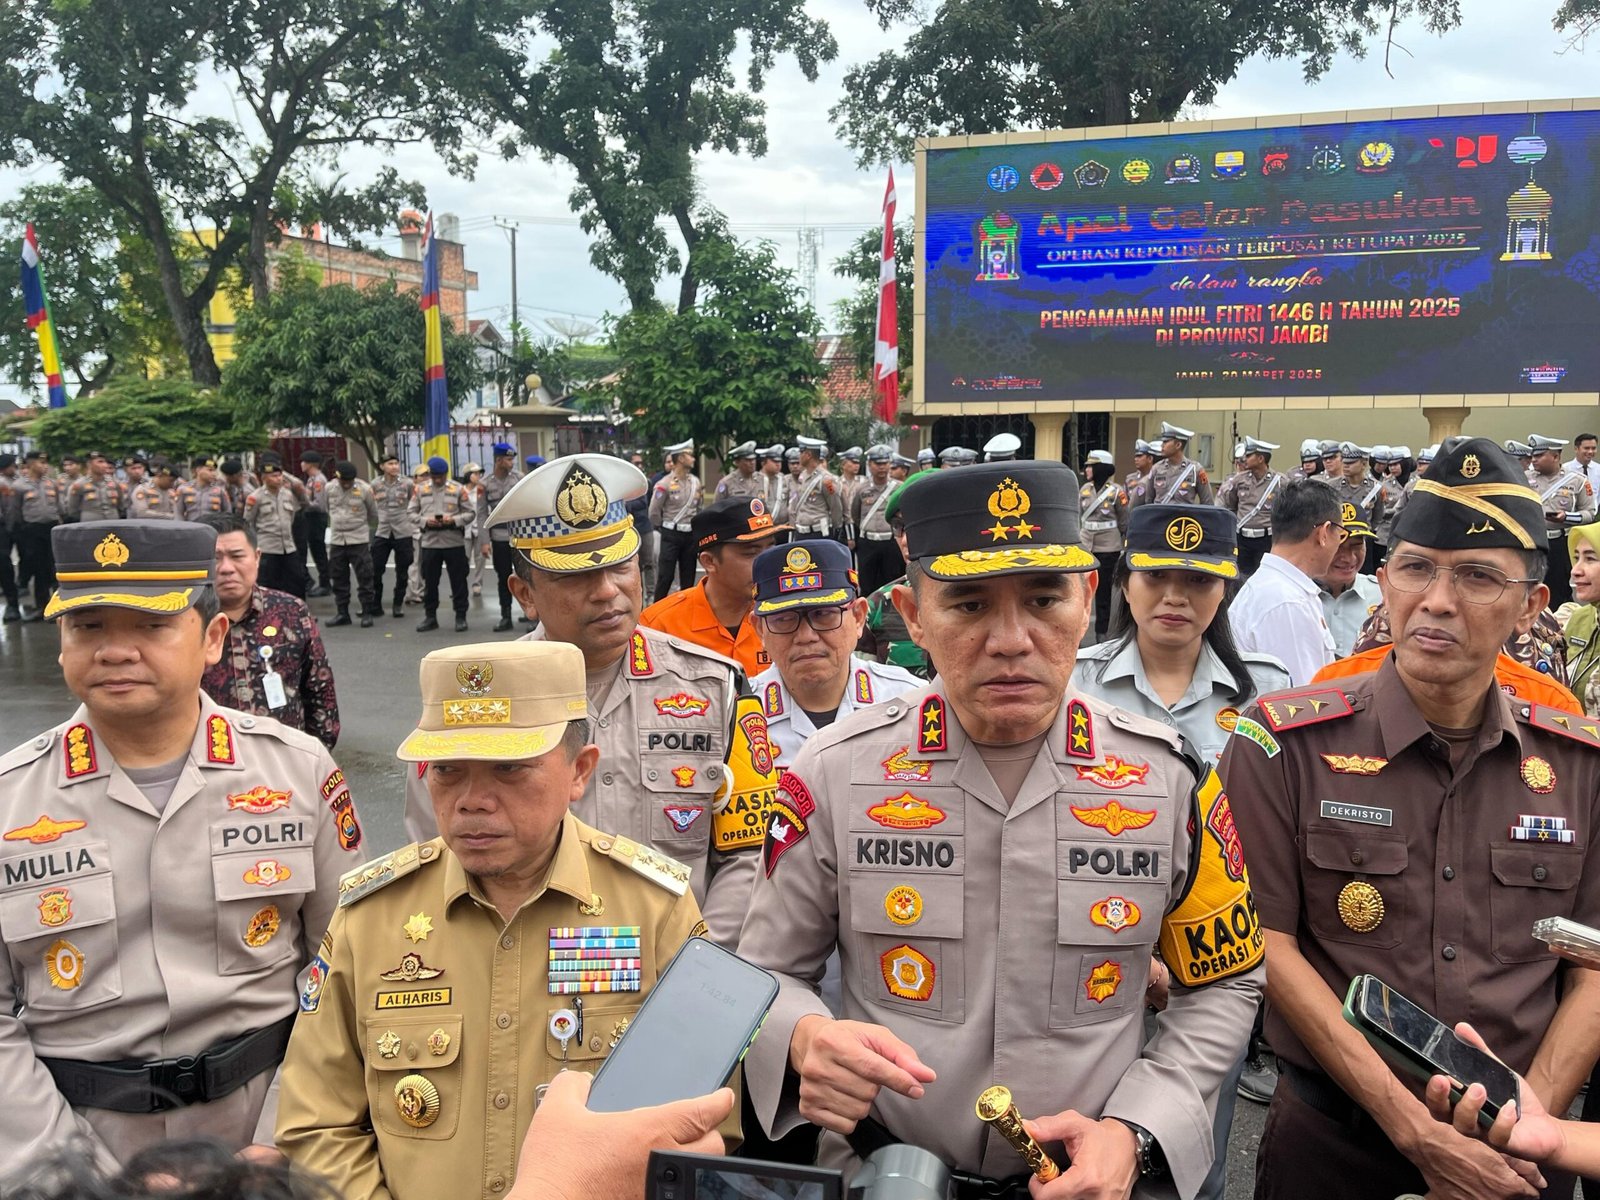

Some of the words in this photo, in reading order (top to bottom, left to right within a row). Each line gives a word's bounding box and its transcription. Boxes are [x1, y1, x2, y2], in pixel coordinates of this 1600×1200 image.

[1037, 205, 1133, 242] Apel
[1150, 200, 1267, 231] Gelar
[1280, 190, 1482, 225] Pasukan
[1047, 247, 1120, 262] OPERASI
[1124, 243, 1230, 260] KEPOLISIAN
[1236, 238, 1327, 255] TERPUSAT
[1332, 233, 1418, 250] KETUPAT
[1422, 231, 1467, 247] 2025
[1169, 273, 1238, 292] dalam
[1246, 266, 1324, 294] rangka
[1040, 306, 1164, 329] PENGAMANAN
[1169, 305, 1212, 325] IDUL
[1215, 303, 1263, 324] FITRI
[1267, 301, 1314, 323] 1446
[1319, 301, 1333, 322] H
[1338, 298, 1404, 320] TAHUN
[1408, 296, 1461, 318] 2025
[1155, 327, 1174, 348] DI
[1179, 326, 1265, 347] PROVINSI
[1270, 323, 1329, 345] JAMBI
[1242, 369, 1285, 381] MARET
[1288, 368, 1323, 380] 2025
[1263, 701, 1283, 727] JAKSA
[648, 732, 712, 753] POLRI
[1330, 805, 1383, 822] DEKRISTO
[222, 822, 304, 848] POLRI
[722, 826, 766, 842] OPERASI
[4, 847, 96, 886] MULIA
[856, 837, 955, 869] KRISNO
[1068, 847, 1159, 879] POLRI
[1189, 943, 1250, 978] OPERASI
[385, 991, 443, 1006] ALHARIS
